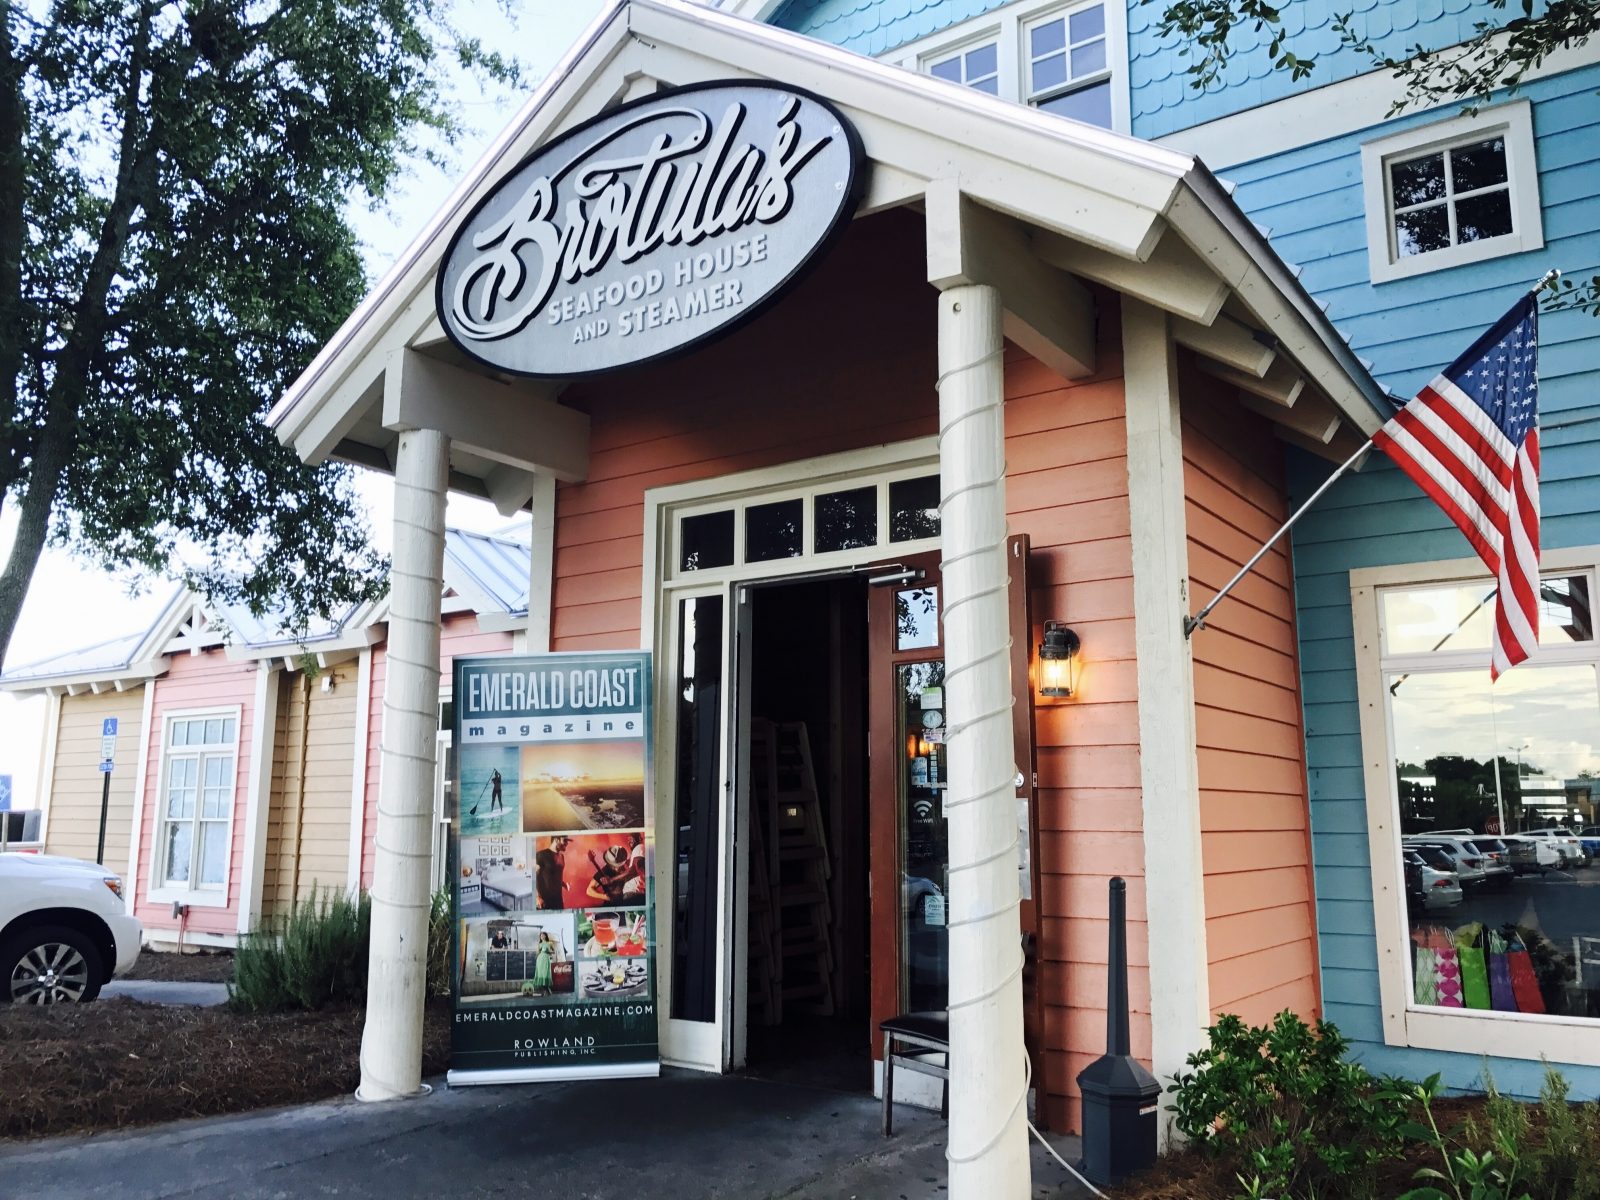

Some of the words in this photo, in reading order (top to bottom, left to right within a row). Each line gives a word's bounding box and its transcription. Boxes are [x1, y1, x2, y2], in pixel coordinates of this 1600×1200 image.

[453, 97, 833, 341] Brotula's
[547, 267, 665, 326] SEAFOOD
[674, 234, 768, 286] HOUSE
[572, 319, 609, 345] AND
[617, 278, 744, 337] STEAMER
[469, 671, 565, 713] EMERALD
[569, 668, 638, 709] COAST
[469, 720, 635, 737] magazine
[456, 1005, 653, 1023] EMERALDCOASTMAGAZINE.COM
[514, 1036, 595, 1050] ROWLAND
